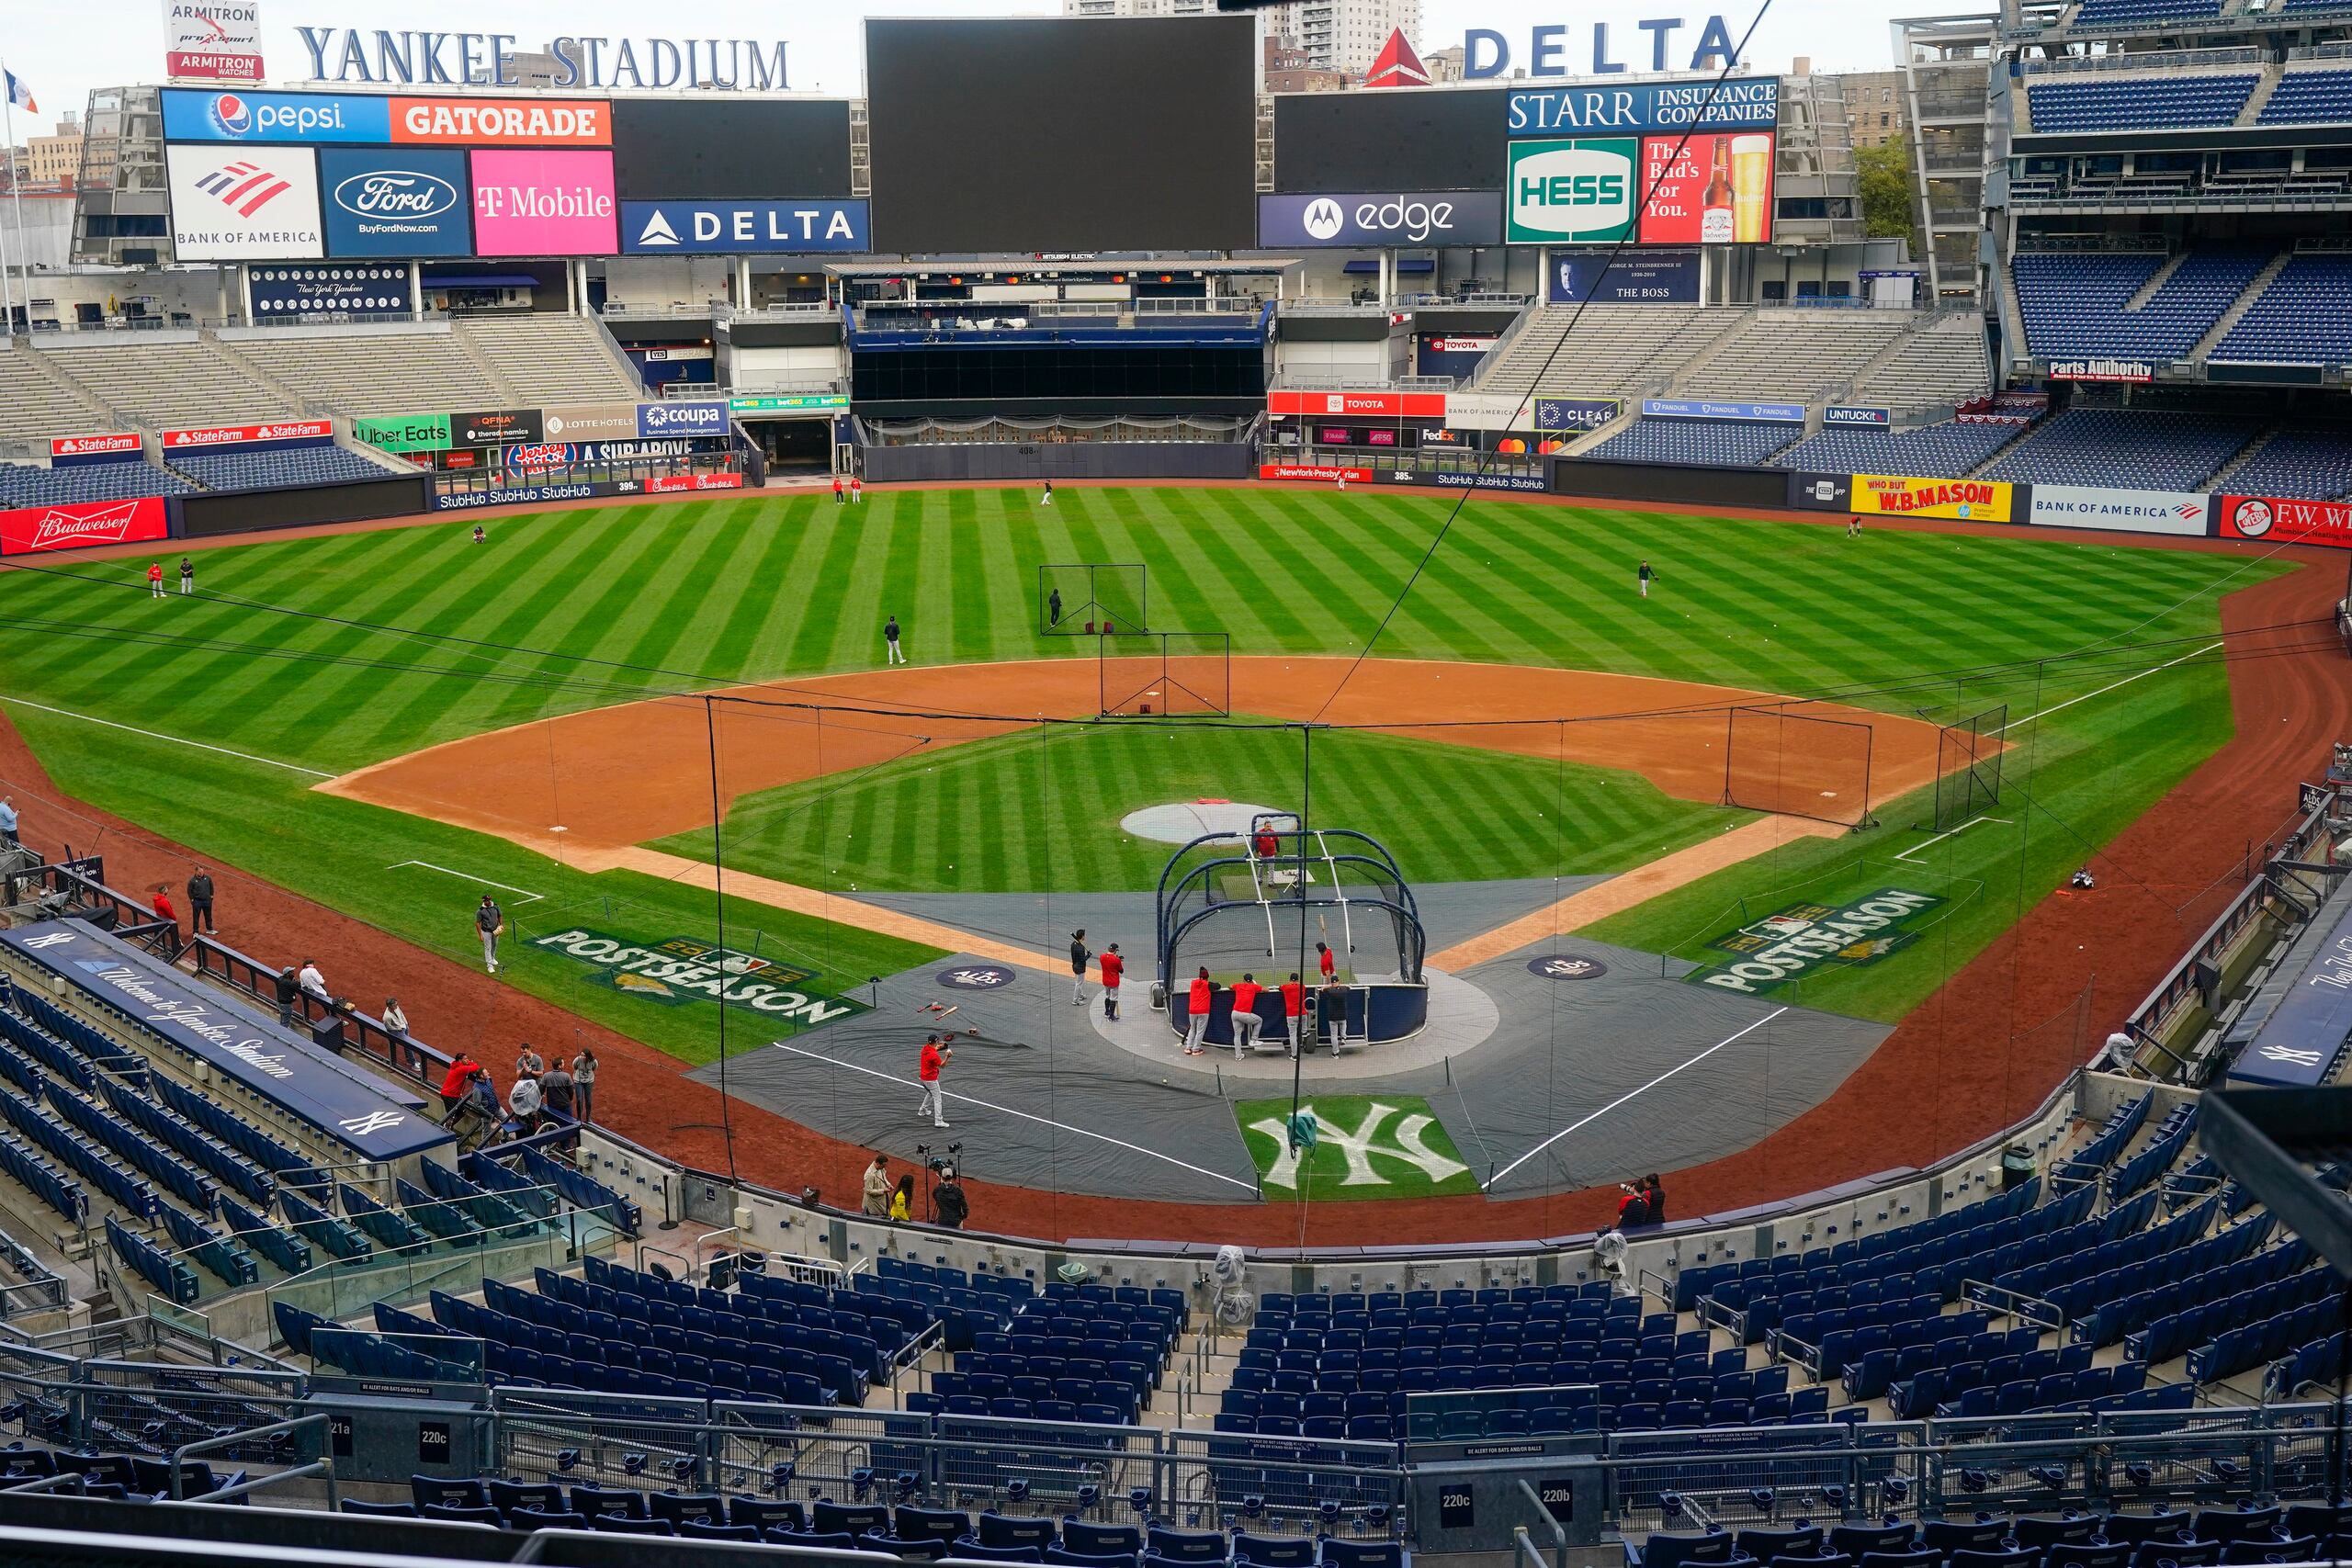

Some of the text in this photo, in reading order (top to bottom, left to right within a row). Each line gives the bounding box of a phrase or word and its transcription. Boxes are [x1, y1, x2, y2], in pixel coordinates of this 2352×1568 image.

[172, 6, 254, 21] ARMITRON
[1464, 15, 1739, 79] DELTA
[181, 55, 254, 69] ARMITRON
[293, 26, 790, 90] YANKEE STADIUM
[218, 68, 254, 76] WATCHES
[1657, 85, 1777, 106] INSURANCE
[257, 103, 341, 133] pepsi
[1509, 92, 1641, 130] STARR
[1657, 103, 1776, 124] COMPANIES
[405, 107, 596, 137] GATORADE
[1649, 142, 1691, 159] This
[1648, 162, 1699, 178] Bud's
[357, 177, 435, 211] Ford
[1521, 175, 1623, 207] HESS
[1649, 182, 1679, 198] For
[510, 186, 612, 217] Mobile
[1648, 200, 1688, 217] You.
[695, 209, 854, 241] DELTA
[1356, 195, 1453, 242] edge
[358, 223, 437, 234] BuyFordNow.com
[177, 231, 317, 244] BANK OF AMERICA
[297, 284, 363, 297] New York Yankees
[1617, 288, 1669, 297] THE BOSS
[2051, 359, 2152, 377] Parts Authority
[1347, 400, 1385, 408] TOYOTA
[668, 408, 719, 425] coupa
[1763, 408, 1792, 416] FANDUEL
[1829, 410, 1875, 421] UNTUCKit
[566, 418, 634, 427] LOTTE HOTELS
[192, 429, 242, 443] StateFarm
[272, 424, 320, 437] StateFarm
[361, 426, 447, 444] Uber Eats
[669, 428, 685, 436] Spend
[686, 427, 720, 435] Management
[1423, 429, 1454, 442] FedEx
[78, 438, 132, 451] StateFarm
[516, 442, 566, 460] Jersey
[583, 446, 595, 467] A
[1438, 474, 1474, 485] StubHub
[1476, 477, 1509, 487] StubHub
[1511, 479, 1544, 490] StubHub
[1867, 480, 1906, 490] WHO BUT
[490, 489, 537, 502] StubHub
[542, 485, 591, 499] StubHub
[1805, 486, 1815, 494] THE
[441, 493, 486, 508] StubHub
[2036, 501, 2167, 518] BANK OF AMERICA
[39, 515, 130, 536] Budweiser
[2243, 511, 2266, 526] WEBB
[1704, 891, 1937, 992] POSTSEASON
[1544, 960, 1591, 974] ALDS
[537, 931, 851, 1023] POSTSEASON
[954, 971, 1001, 984] ALDS
[97, 967, 164, 1004] Welcome
[146, 1005, 238, 1042] Yankee
[220, 1039, 294, 1078] Stadium
[423, 1431, 447, 1444] 220c
[1443, 1495, 1470, 1508] 220c
[1544, 1488, 1570, 1503] 220b
